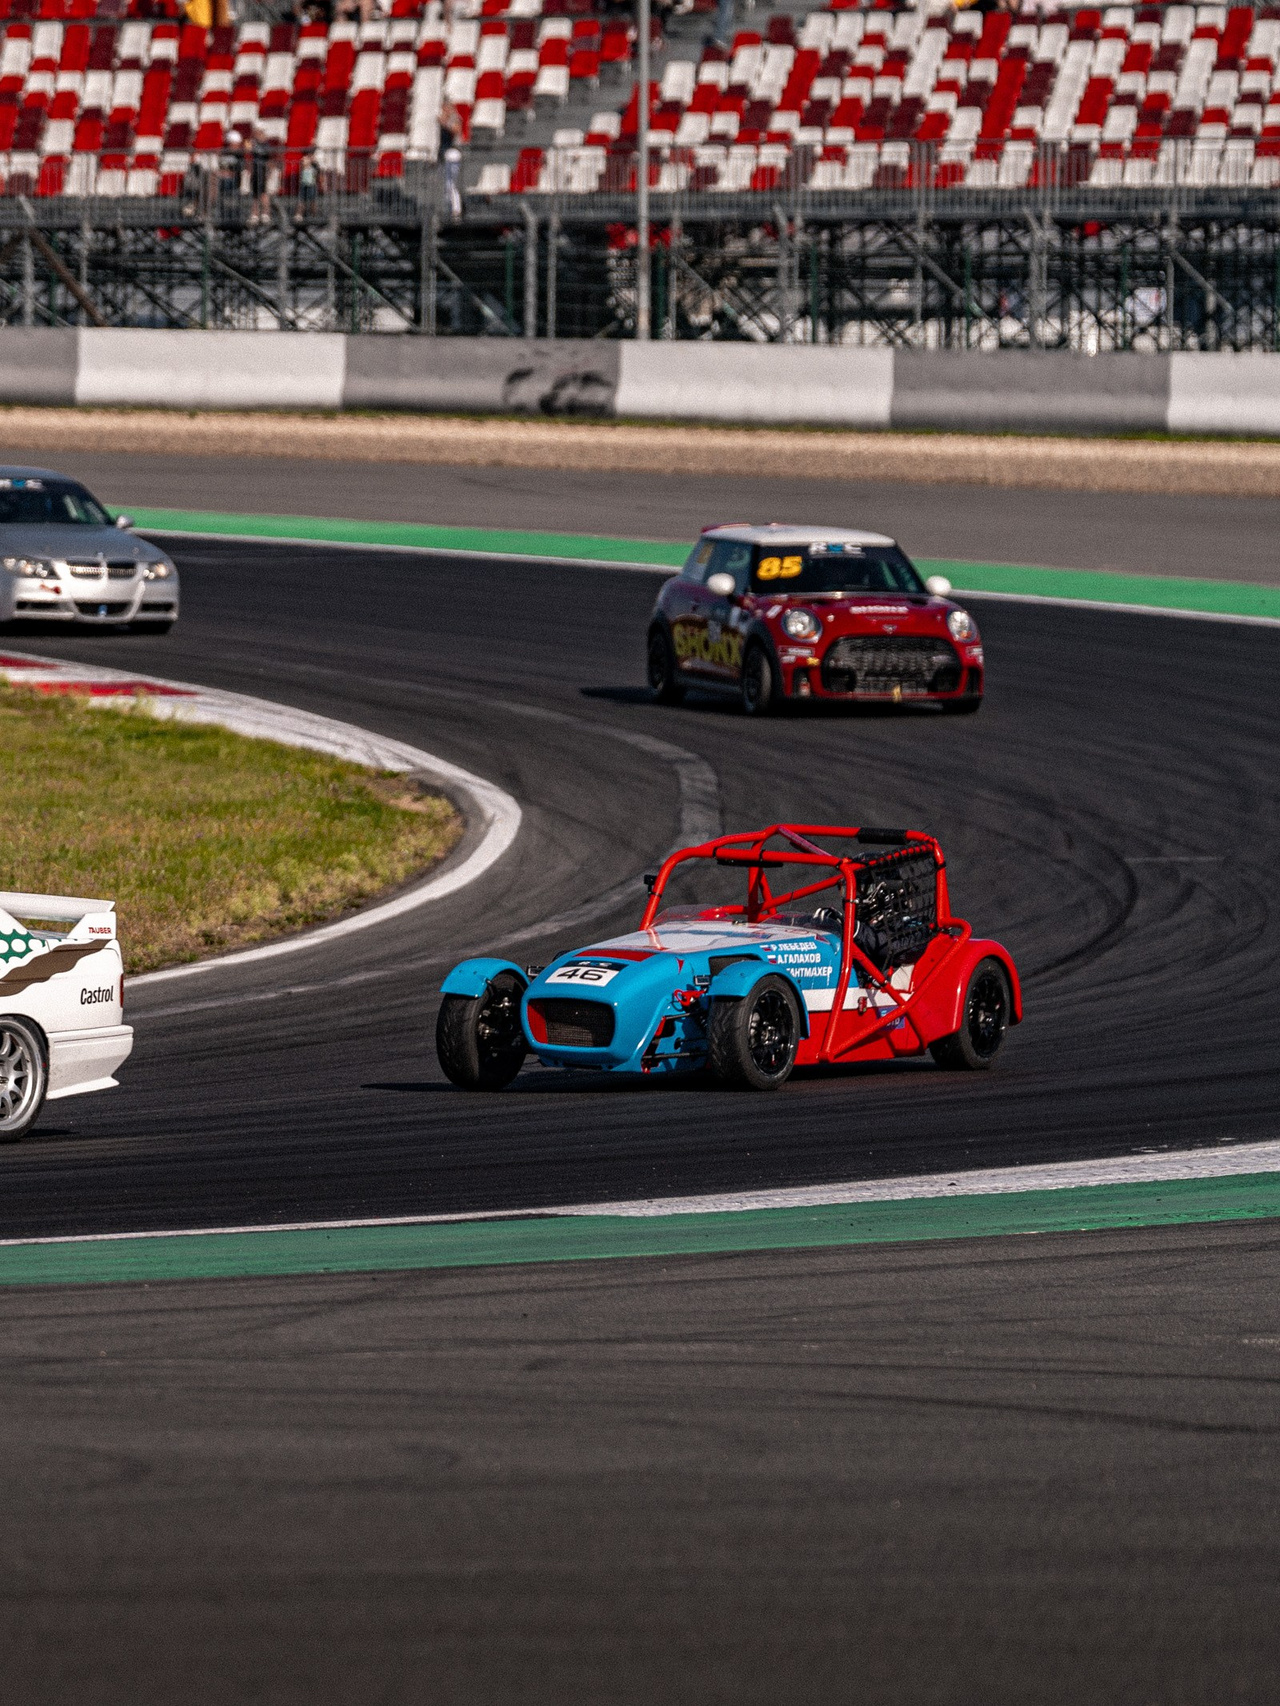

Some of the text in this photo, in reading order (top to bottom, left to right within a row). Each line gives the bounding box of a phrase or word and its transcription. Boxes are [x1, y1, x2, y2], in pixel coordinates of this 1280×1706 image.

[756, 556, 802, 580] 85
[557, 968, 608, 981] 46
[786, 966, 833, 979] АНТМАХЕР
[80, 985, 114, 1005] Castrol
